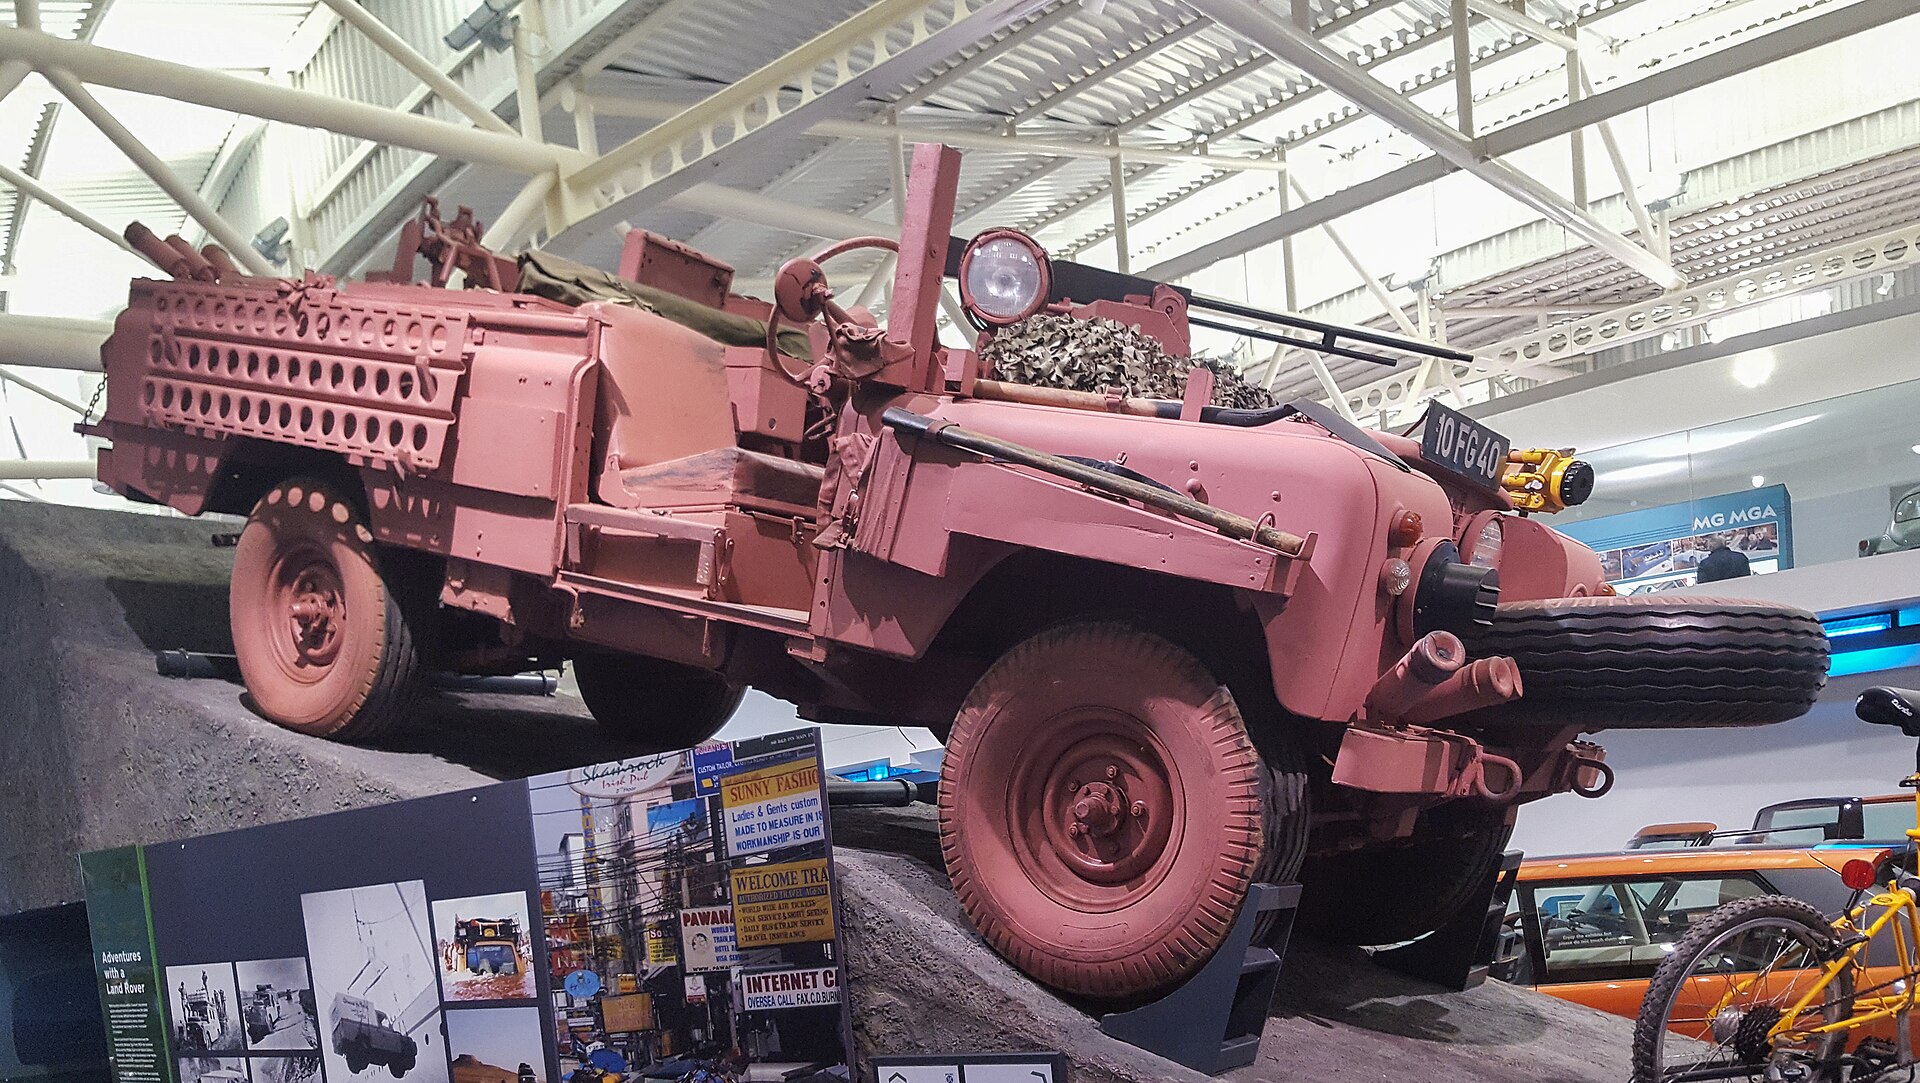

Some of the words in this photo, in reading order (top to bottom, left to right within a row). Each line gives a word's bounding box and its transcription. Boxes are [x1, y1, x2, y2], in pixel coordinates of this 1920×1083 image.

[1435, 413, 1455, 458] 10
[1453, 422, 1479, 469] FG
[1476, 437, 1501, 479] 40
[1692, 513, 1725, 531] MG
[1729, 504, 1777, 524] MGA
[582, 753, 667, 785] Shamrock
[630, 771, 649, 785] Pub
[730, 779, 770, 802] SUNNY
[732, 808, 755, 823] Ladies
[757, 805, 764, 817] &
[766, 802, 788, 816] Gents
[790, 797, 818, 811] custom
[735, 823, 756, 837] MADE
[757, 821, 768, 833] TO
[768, 813, 804, 831] MEASURE
[805, 812, 814, 823] IN
[736, 831, 791, 852] WORKMANSHIP
[792, 829, 801, 841] IS
[803, 825, 821, 838] OUR
[734, 870, 799, 892] WELCOME
[801, 866, 829, 885] TRA
[739, 891, 778, 904] AUTHORIZED
[780, 889, 803, 901] TRAVEL
[805, 885, 827, 897] AGENT
[741, 904, 761, 914] WORLD
[761, 902, 777, 912] WIDE
[778, 901, 789, 911] AIR
[790, 899, 816, 909] TICKETS
[742, 916, 756, 924] VISA
[757, 914, 781, 923] SERVICE
[806, 908, 829, 917] SEEING
[743, 925, 760, 933] DAILY
[799, 918, 825, 927] SERVICE
[745, 933, 767, 942] TRAVEL
[769, 931, 807, 940] INSURANCE
[102, 951, 142, 964] Adventures
[104, 967, 120, 980] with
[120, 969, 126, 979] a
[746, 970, 819, 994] INTERNET
[106, 982, 123, 995] Land
[124, 982, 145, 994] Rover
[747, 994, 777, 1009] OVERSEA
